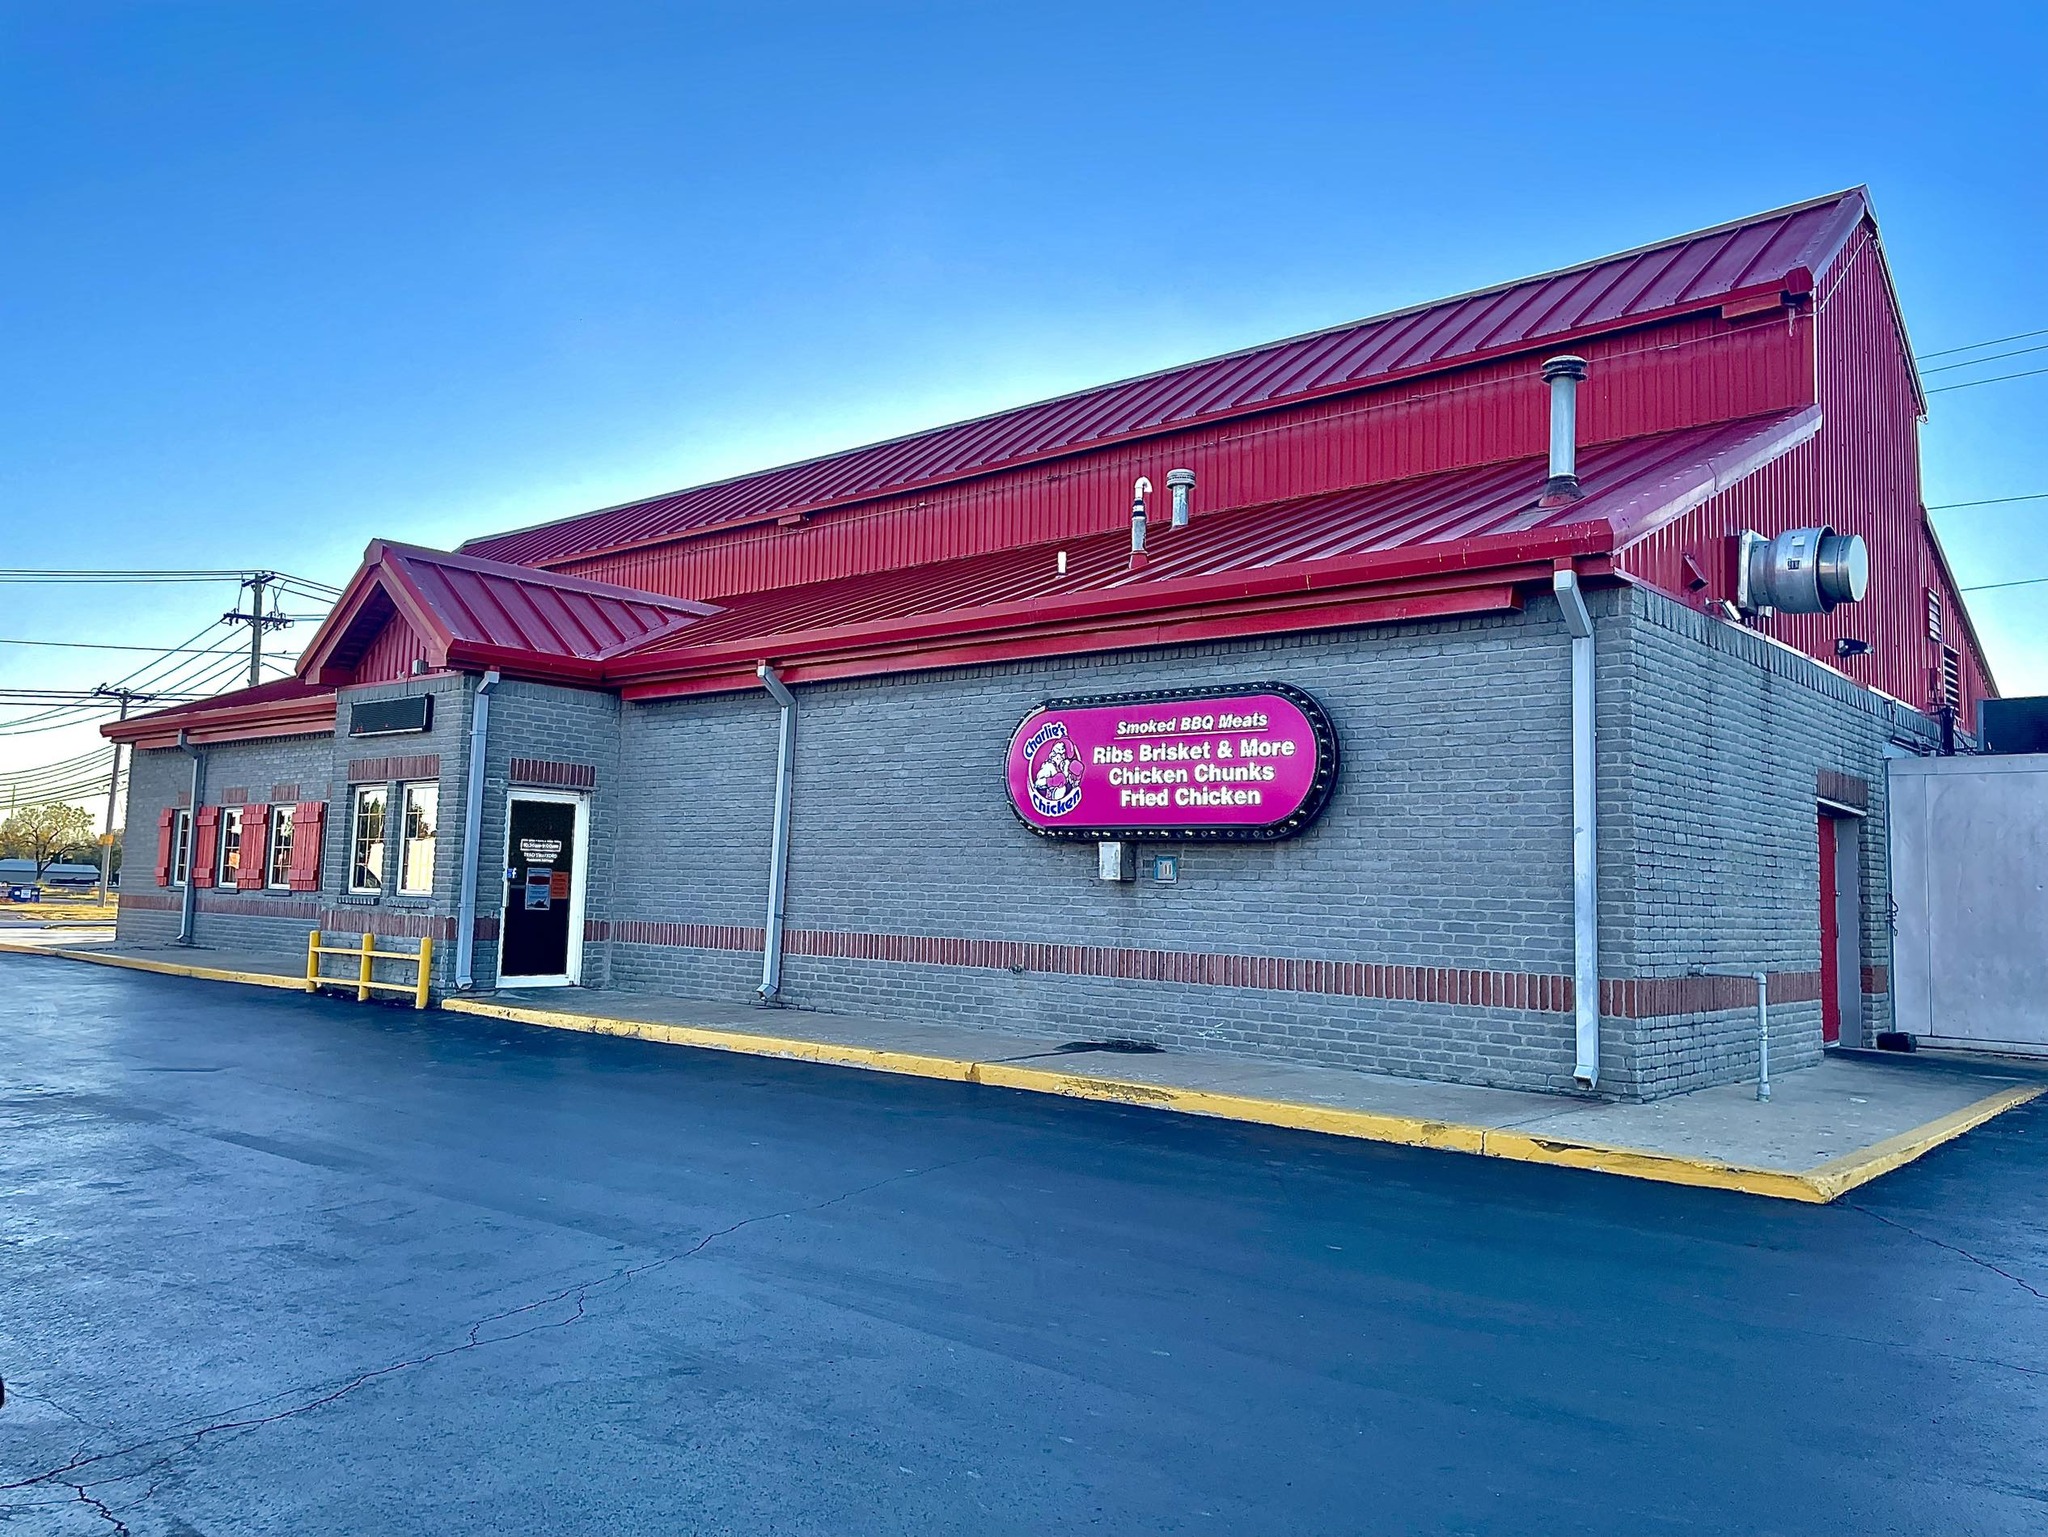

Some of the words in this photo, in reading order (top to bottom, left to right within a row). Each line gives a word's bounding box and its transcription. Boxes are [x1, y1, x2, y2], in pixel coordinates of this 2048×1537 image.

[1116, 717, 1176, 735] Smoked
[1180, 715, 1214, 731] BBQ
[1218, 712, 1268, 729] Meats
[1025, 723, 1066, 758] Charlie's
[1093, 746, 1134, 764] Ribs
[1139, 742, 1211, 762] Brisket
[1217, 740, 1233, 759] &
[1240, 738, 1295, 757] More
[1109, 767, 1188, 785] Chicken
[1194, 762, 1275, 783] Chunks
[1033, 789, 1080, 815] Chicken
[1121, 788, 1169, 807] Fried
[1175, 786, 1261, 806] Chicken
